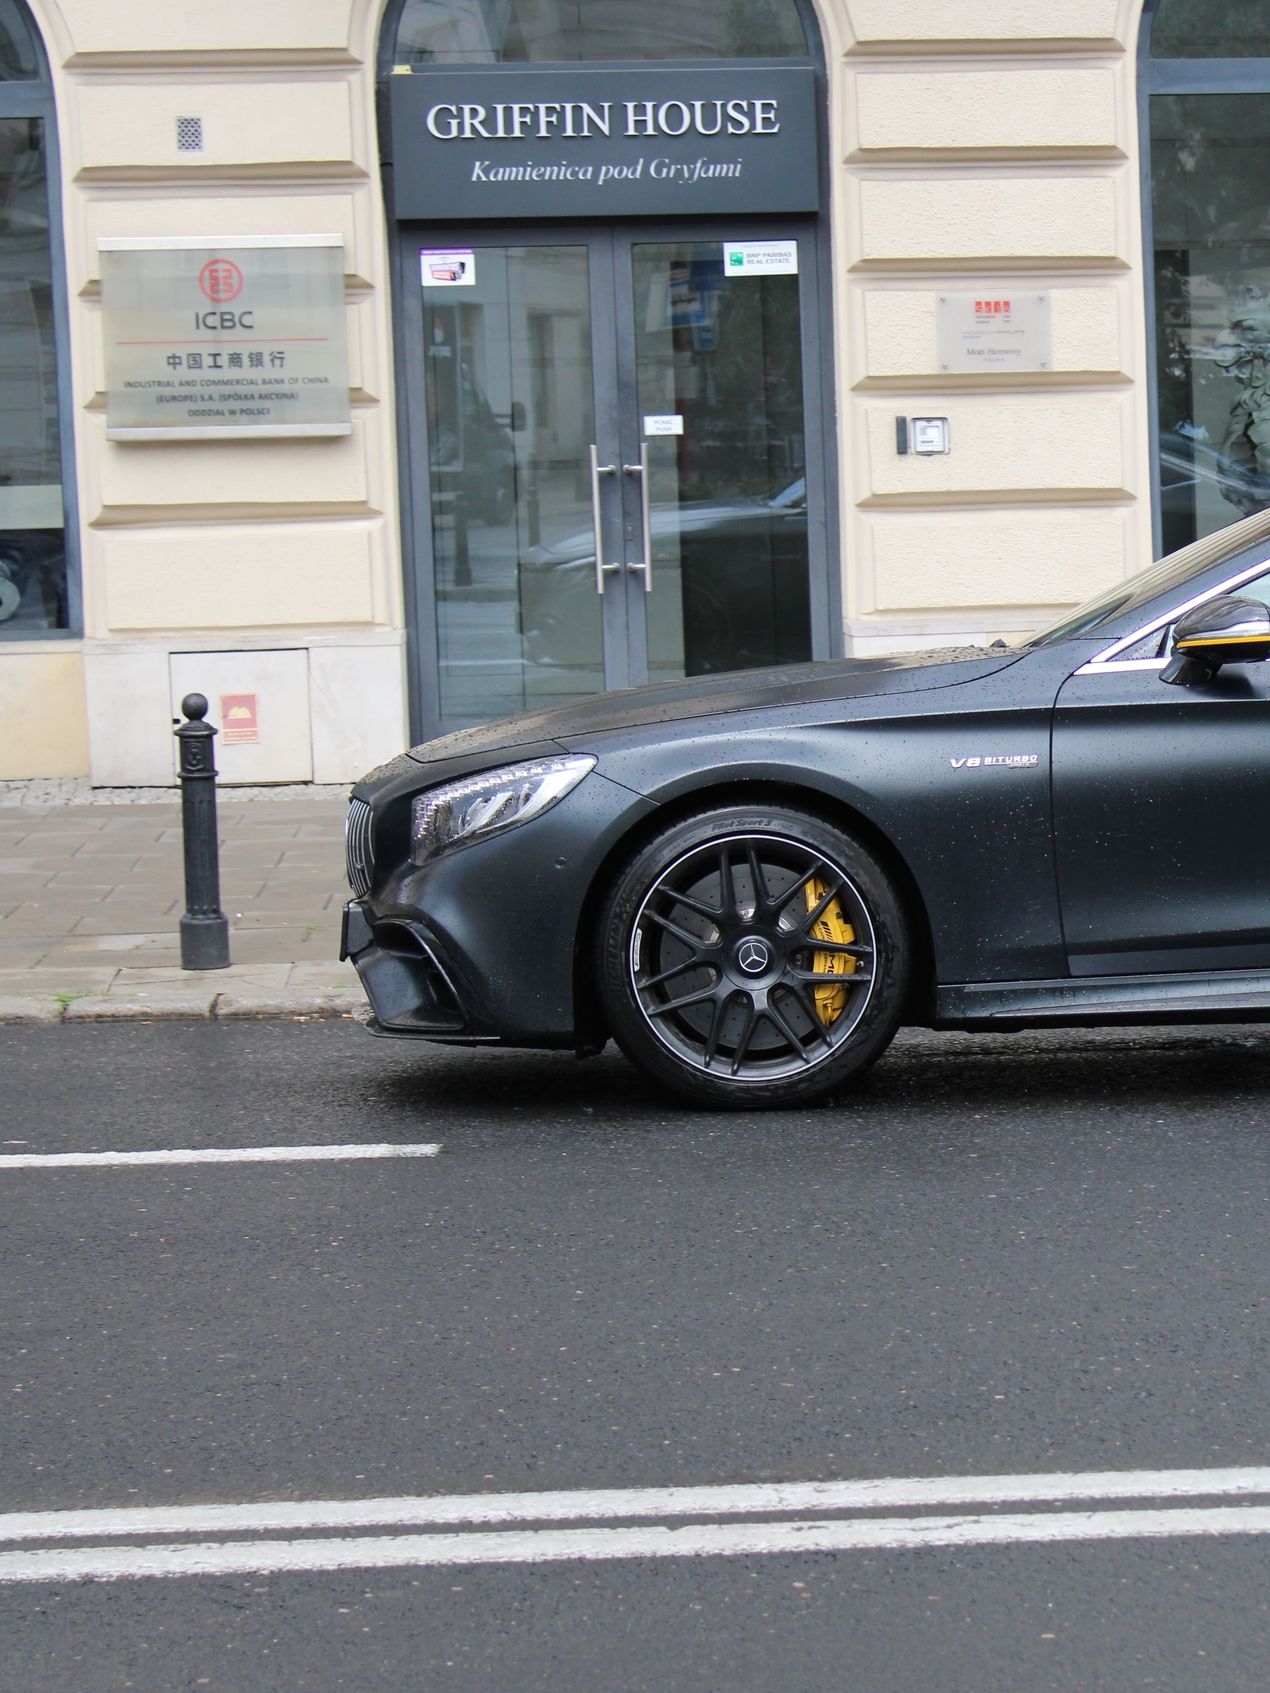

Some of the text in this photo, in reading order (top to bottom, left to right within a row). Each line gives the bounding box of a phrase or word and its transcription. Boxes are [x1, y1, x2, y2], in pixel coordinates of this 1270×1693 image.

[426, 100, 780, 139] GRIFFIN HOUSE
[471, 157, 742, 185] Kamienica pod Gryfami
[195, 311, 254, 330] ICBC
[167, 351, 286, 370] 中国工商银行
[124, 380, 176, 388] INDUSTRIAL
[178, 379, 197, 387] AND
[200, 378, 259, 387] COMMERCIAL
[288, 377, 299, 385] OF
[301, 376, 329, 384] CHINA
[156, 394, 198, 404] (EUROPE)
[239, 407, 271, 415] POLSCE
[950, 754, 1038, 768] V8 BITURBO
[736, 818, 763, 828] Sport
